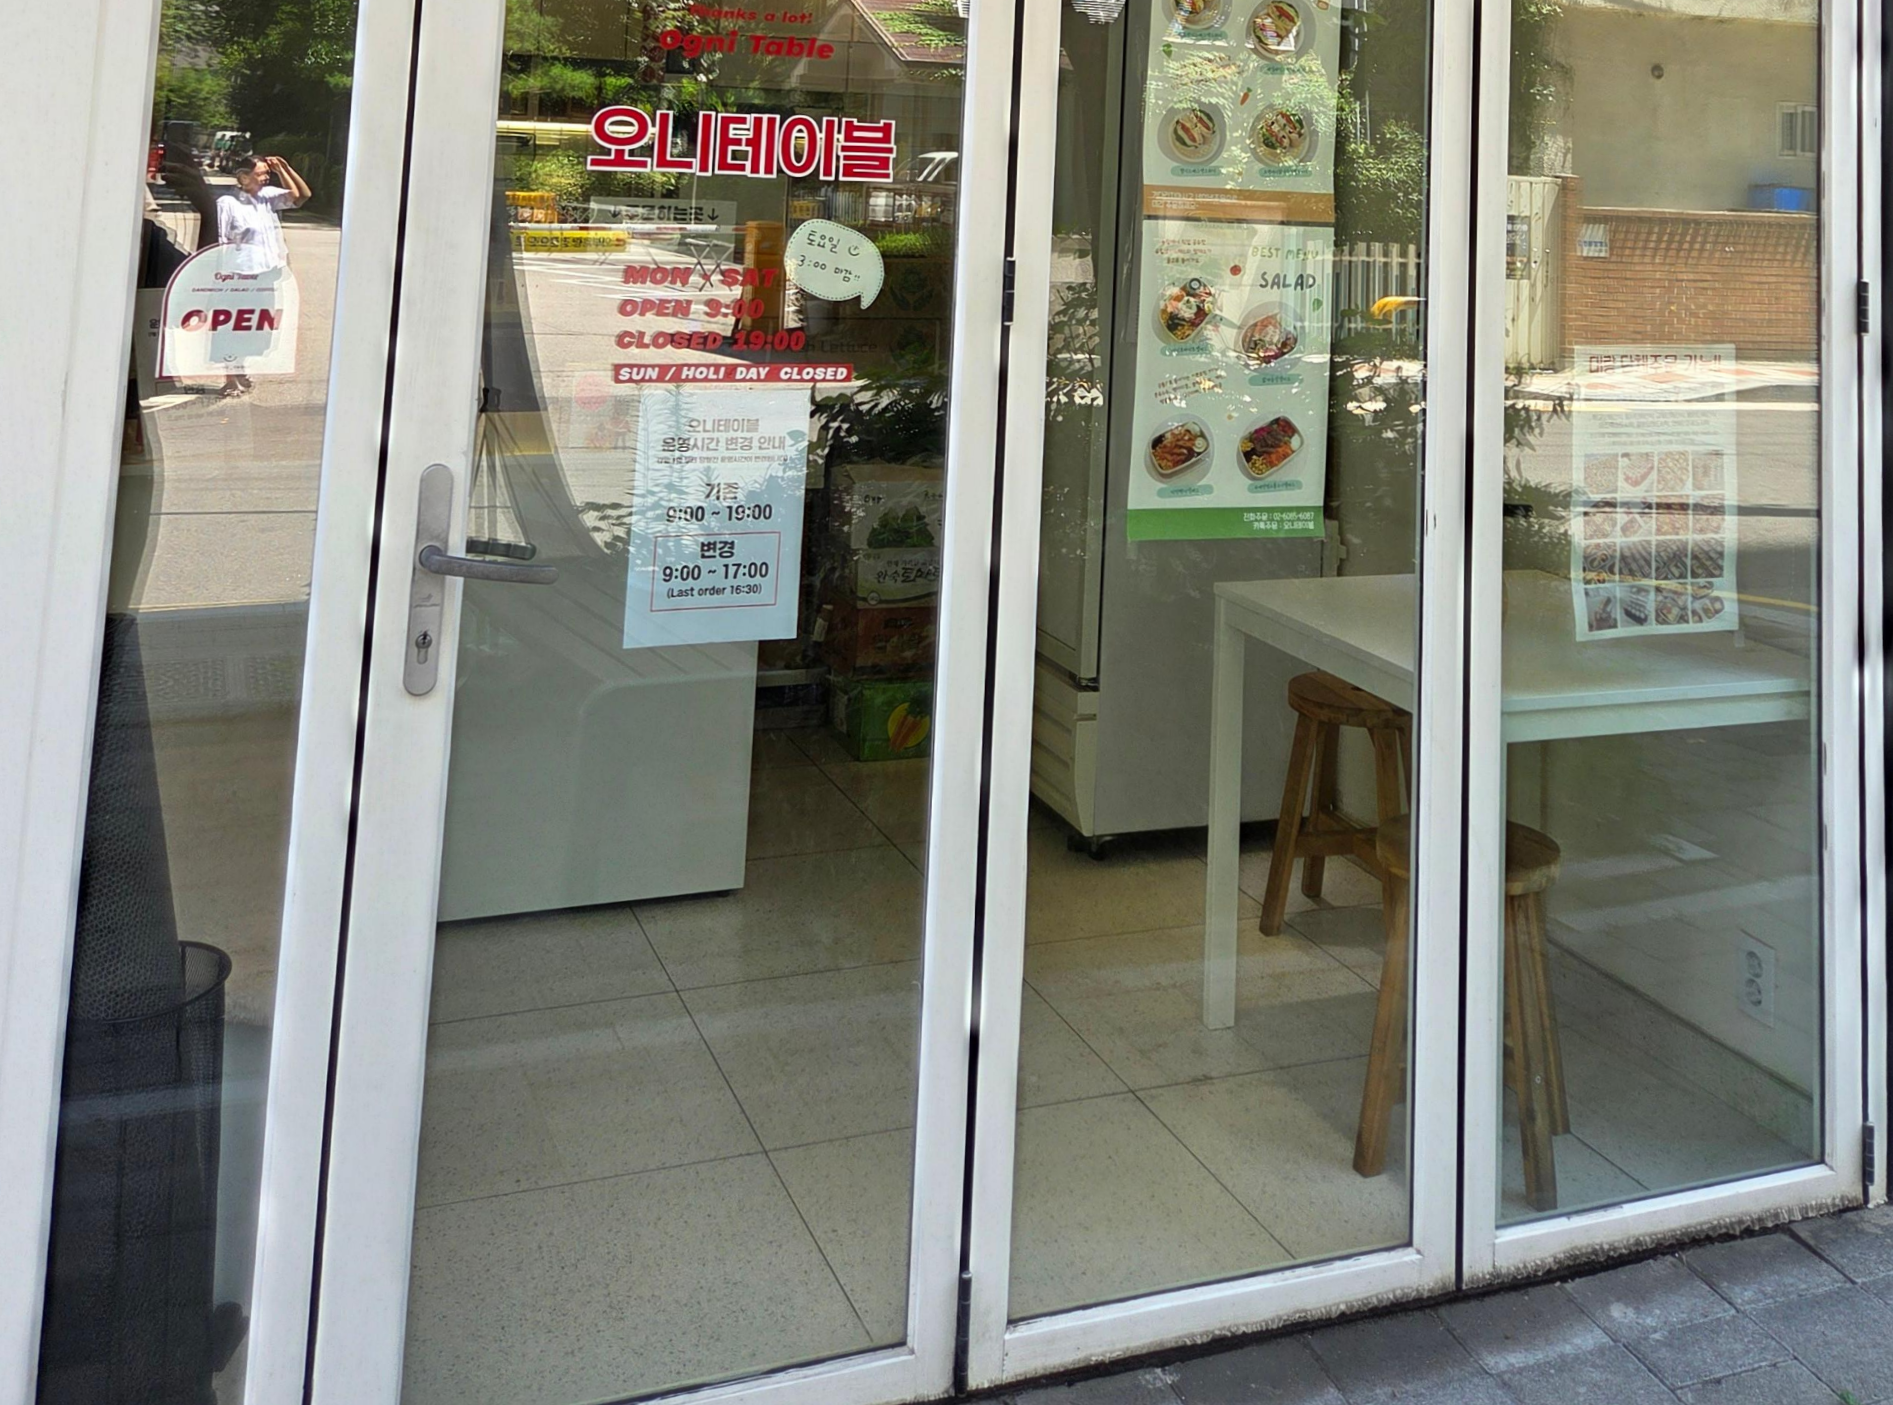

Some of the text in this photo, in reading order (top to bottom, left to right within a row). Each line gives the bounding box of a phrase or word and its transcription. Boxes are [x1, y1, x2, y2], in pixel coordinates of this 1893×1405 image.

[689, 3, 813, 24] Thanks a lot!
[659, 28, 835, 60] Ogni Table
[587, 105, 897, 183] 오니테이블
[806, 230, 841, 254] 토요일
[797, 254, 827, 271] 3:00
[1251, 246, 1281, 259] BEST
[622, 265, 693, 287] MON
[719, 267, 779, 288] SAT
[1258, 271, 1317, 291] SALAD
[618, 298, 765, 319] OPEN 9:00
[180, 308, 284, 333] OPEN
[614, 330, 724, 351] CLOSED
[732, 330, 806, 352] 19:00
[618, 366, 660, 381] SUN
[734, 366, 770, 380] DAY
[779, 366, 848, 381] CLOSED
[686, 418, 760, 434] 오니테이블
[661, 435, 787, 453] 운영시간 변경 안내
[704, 482, 739, 501] 기존
[665, 504, 706, 523] 9:00
[727, 503, 773, 522] 19:00
[700, 540, 736, 559] 변경
[662, 564, 702, 583] 9:00
[722, 561, 769, 580] 17:00
[666, 582, 763, 599] (Last order 16:30)
